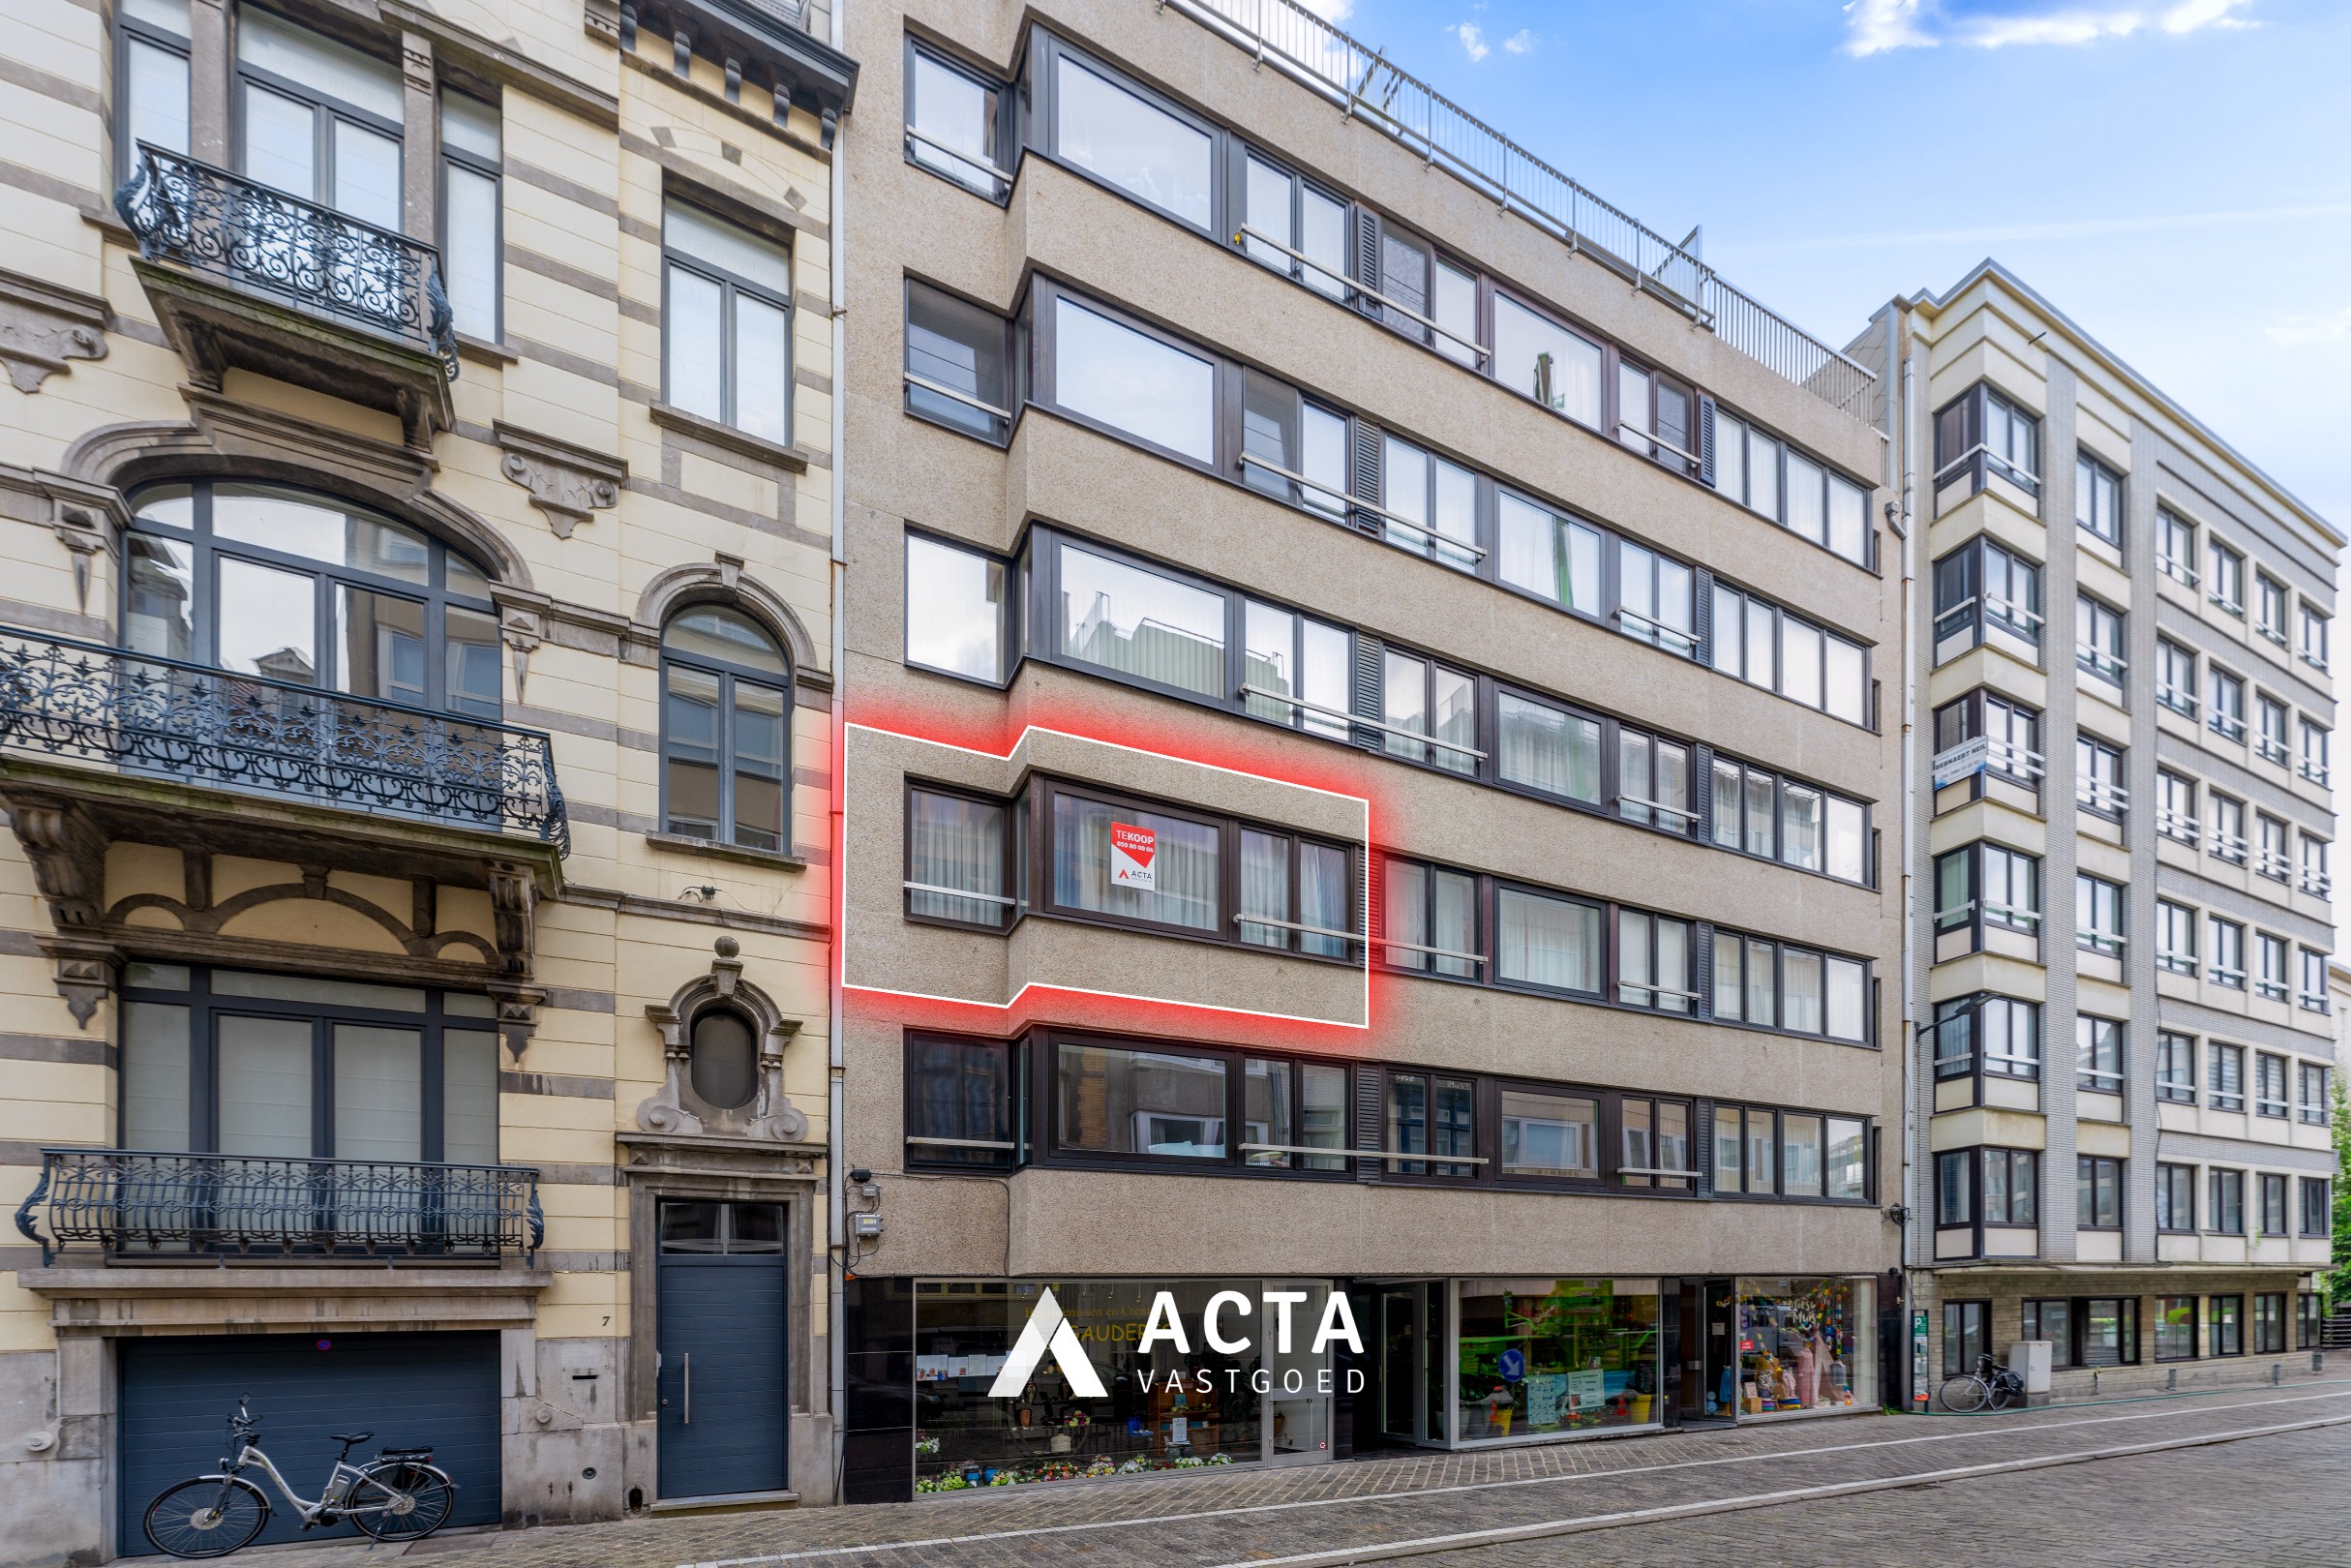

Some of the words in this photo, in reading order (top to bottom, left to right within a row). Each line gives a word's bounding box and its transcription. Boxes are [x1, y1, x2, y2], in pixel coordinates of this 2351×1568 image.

[1131, 870, 1153, 880] ACTA
[602, 1316, 611, 1326] 7
[1914, 1317, 1922, 1329] P
